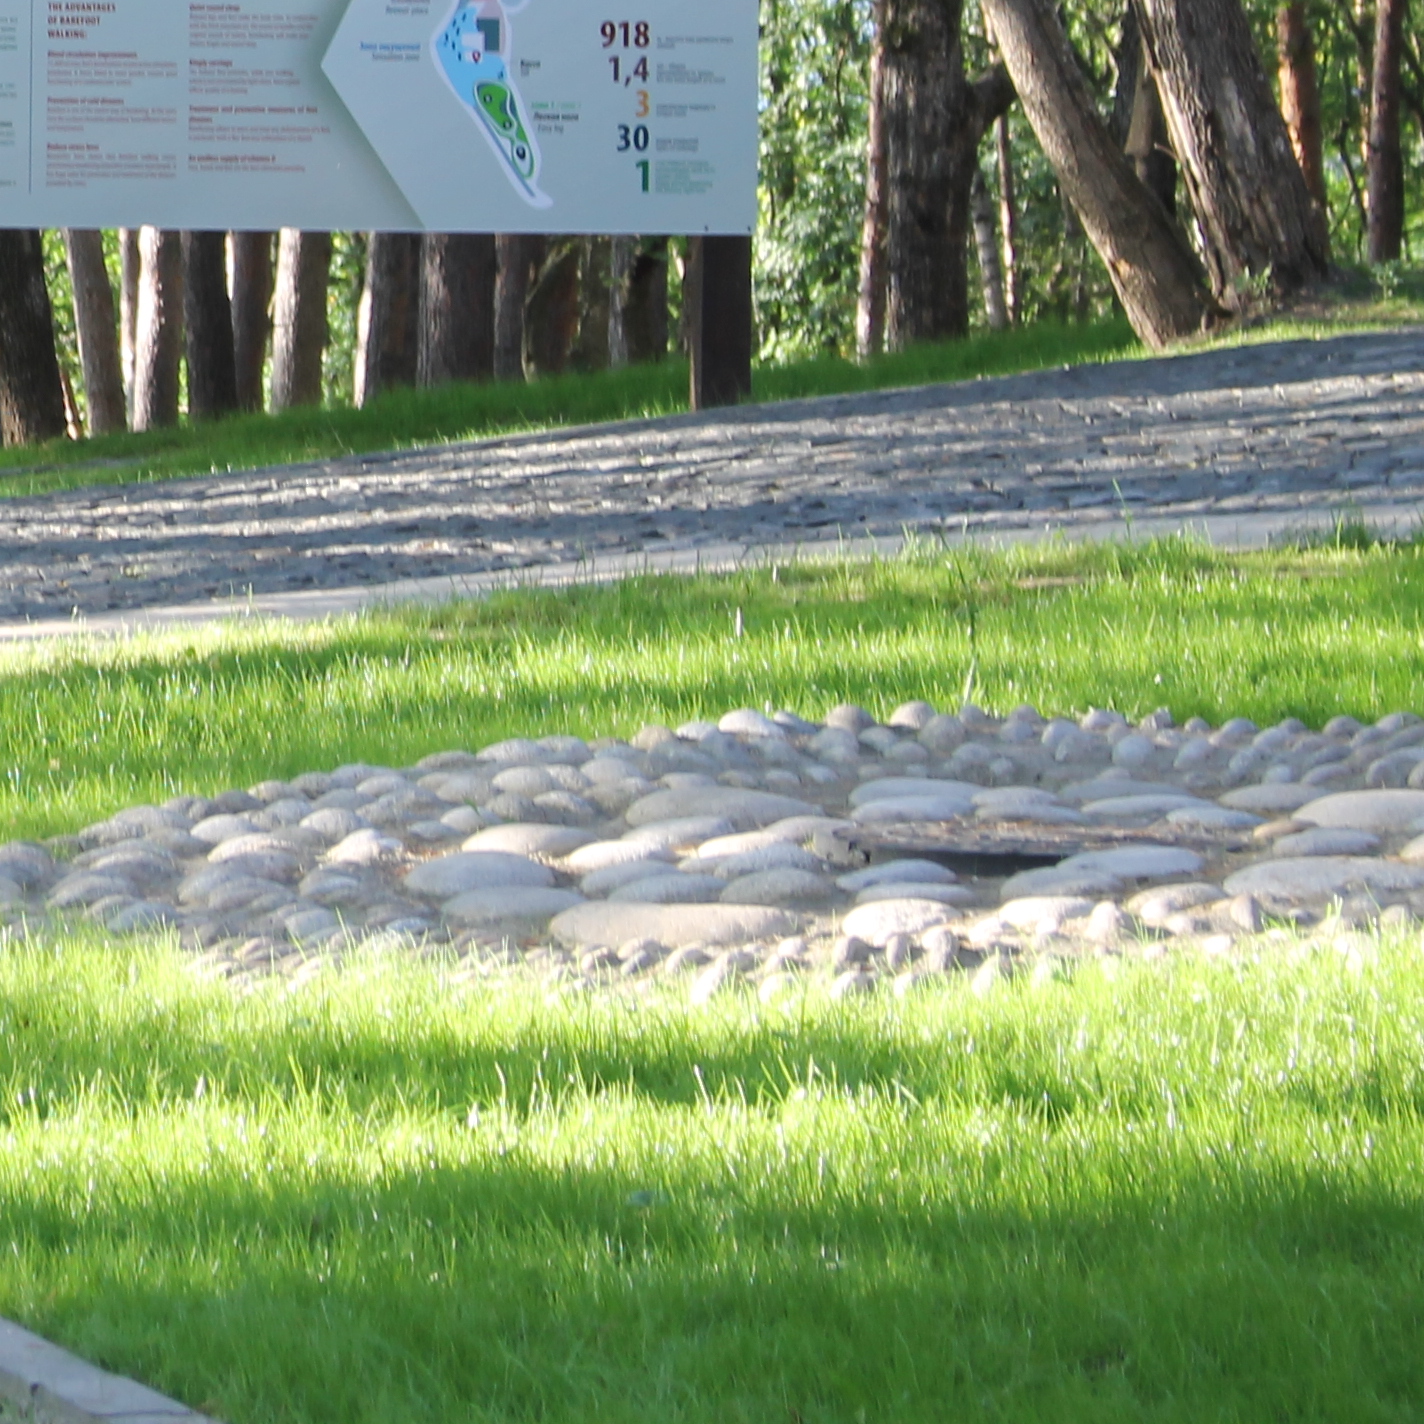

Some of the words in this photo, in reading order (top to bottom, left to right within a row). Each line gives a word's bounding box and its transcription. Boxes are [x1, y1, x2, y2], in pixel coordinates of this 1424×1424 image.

[48, 2, 63, 13] THE
[599, 19, 650, 49] 918
[608, 55, 650, 88] 1,4
[635, 89, 650, 118] 3
[616, 123, 650, 152] 30
[635, 158, 650, 193] 1
